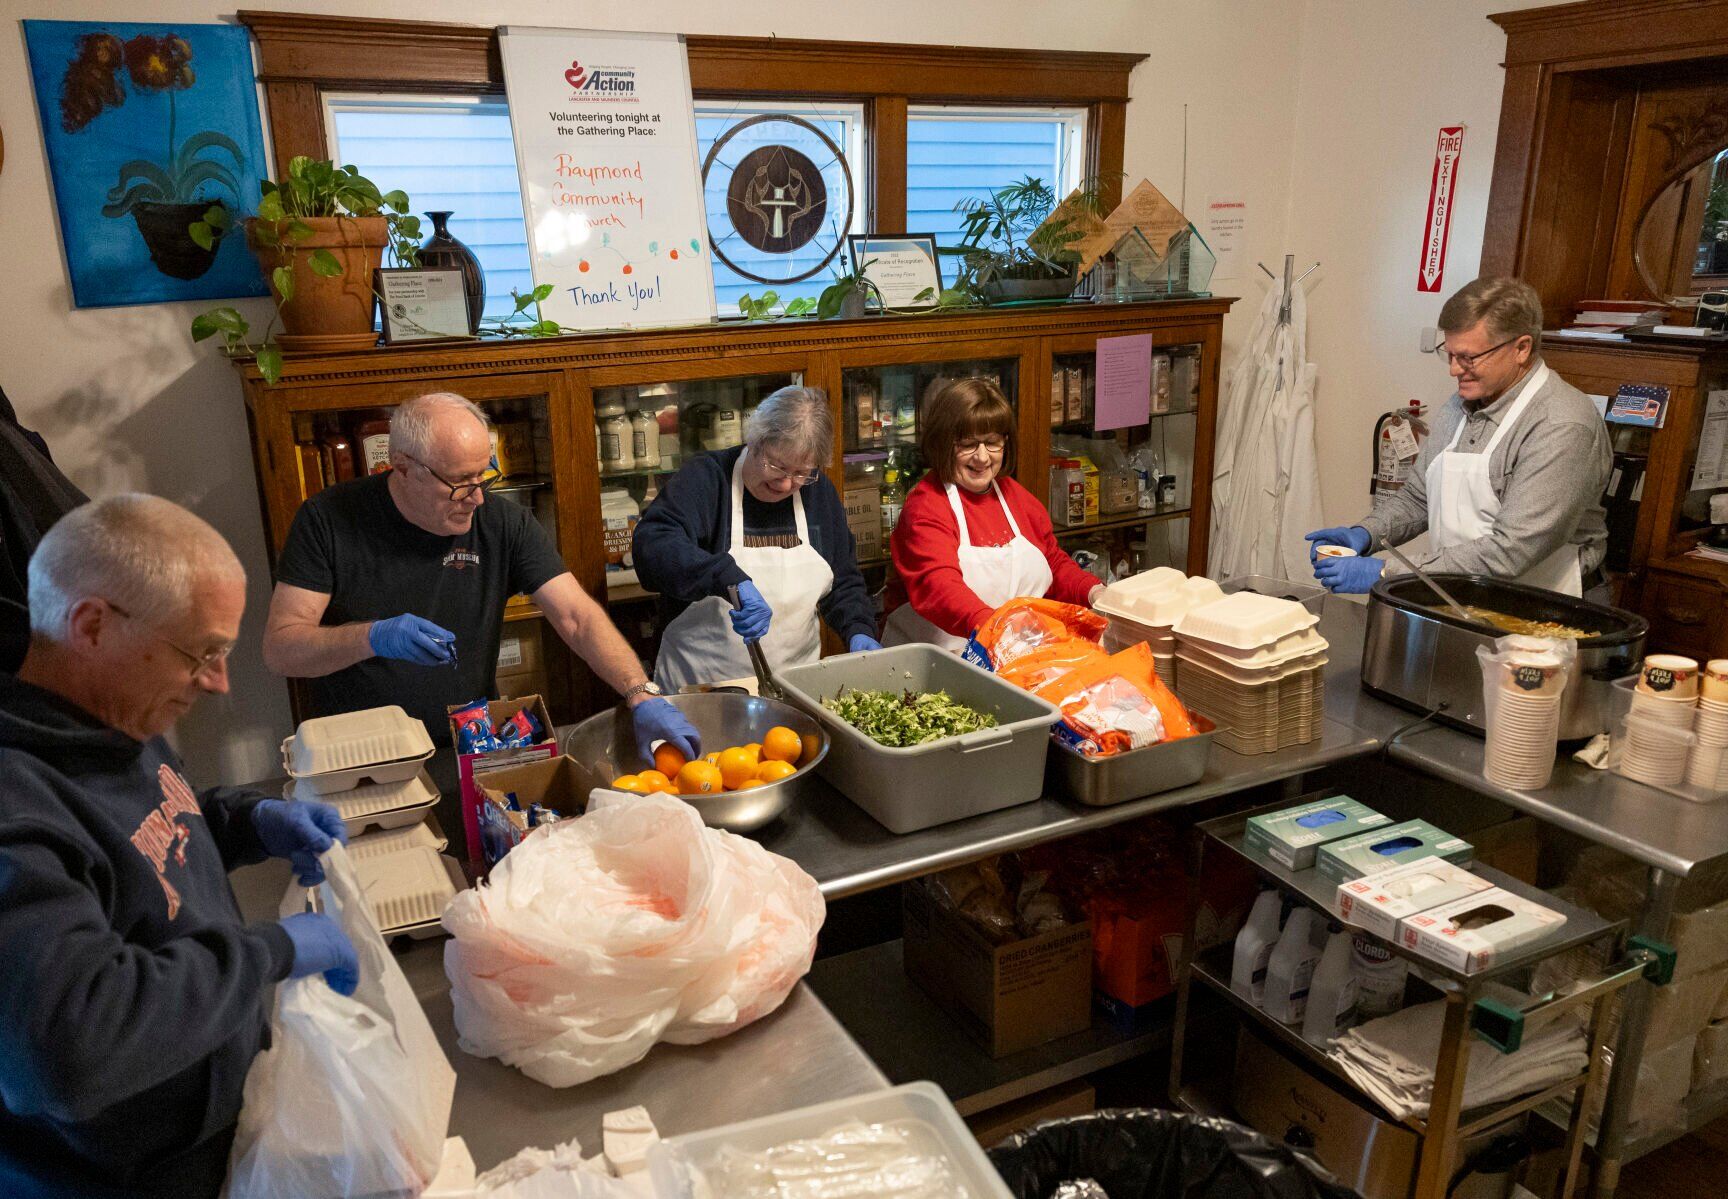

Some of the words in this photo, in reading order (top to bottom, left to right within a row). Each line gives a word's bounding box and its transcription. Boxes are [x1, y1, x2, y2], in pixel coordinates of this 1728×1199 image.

[582, 71, 635, 91] Action
[549, 112, 613, 123] Volunteering
[615, 113, 650, 124] tonight
[652, 114, 661, 122] at
[557, 127, 574, 136] the
[577, 126, 625, 137] Gathering
[627, 126, 656, 136] Place:
[1440, 137, 1460, 152] FIRE
[553, 153, 643, 186] Raymond
[552, 181, 643, 220] Community
[1428, 155, 1451, 277] EXTINGUISHER
[566, 281, 622, 306] Thank
[628, 275, 662, 311] You!
[863, 504, 872, 513] OIL
[605, 530, 632, 539] RANCH
[1000, 949, 1027, 965] DRIED
[1355, 939, 1391, 960] CLOROX
